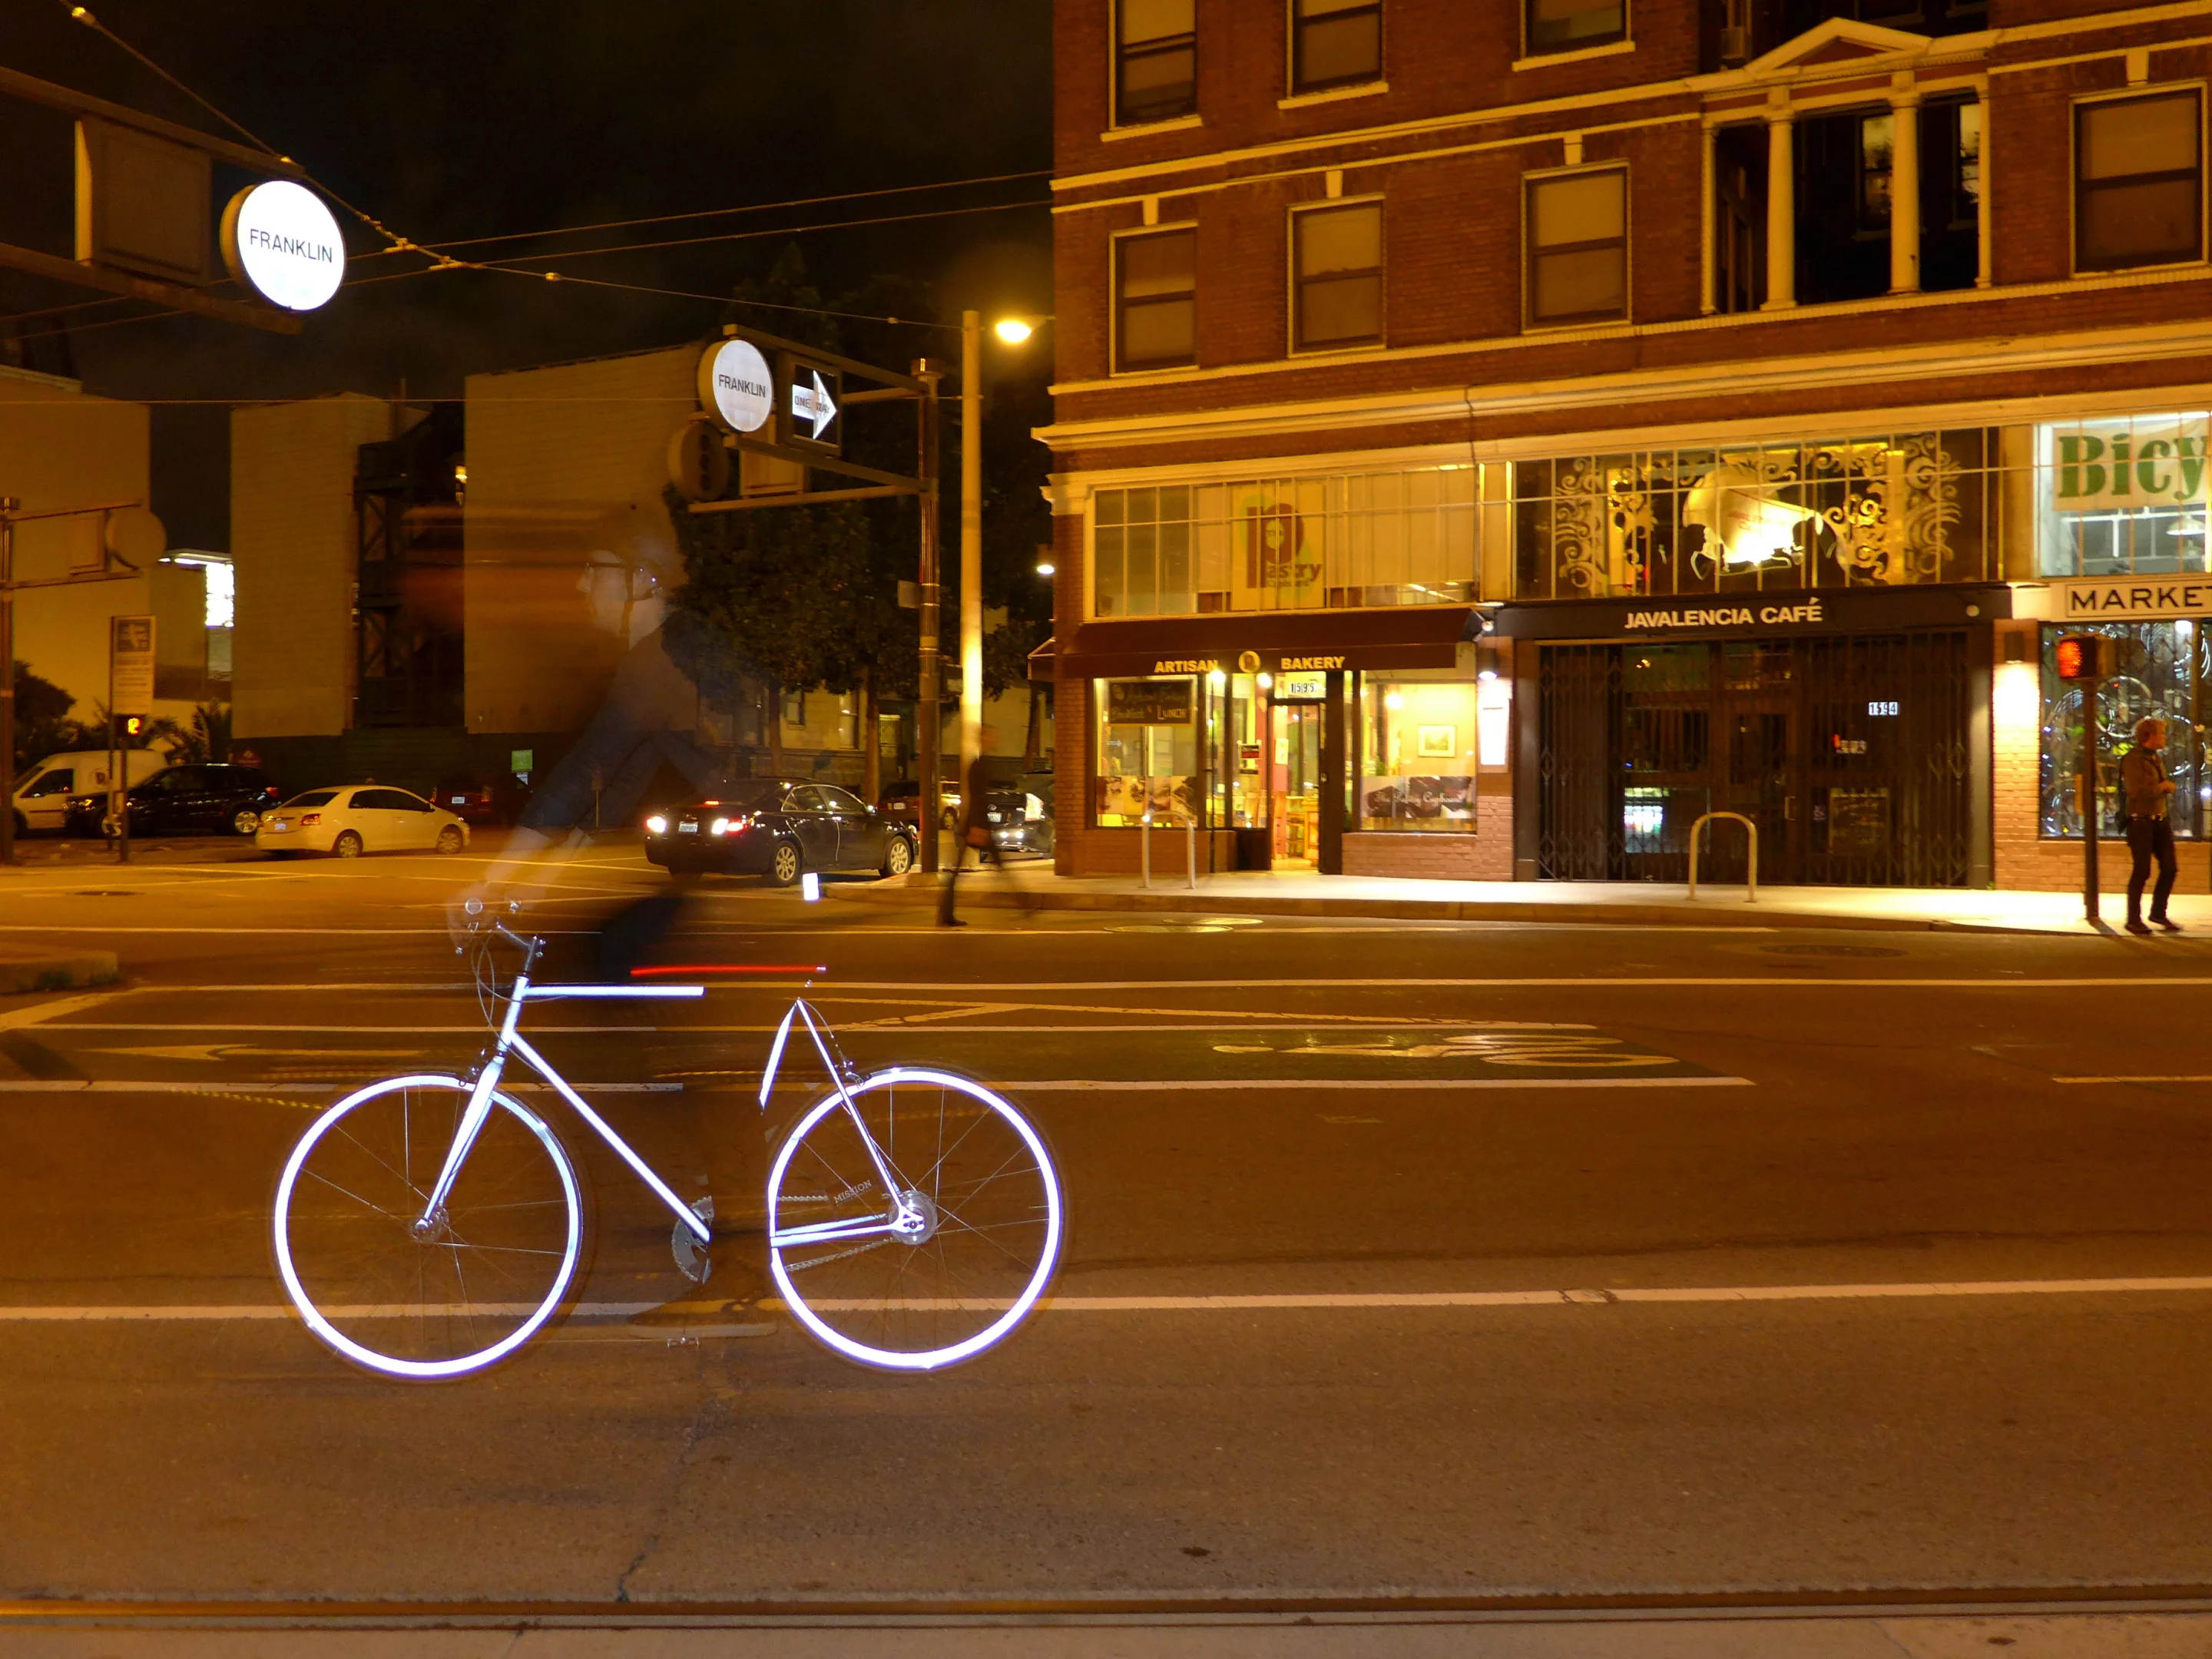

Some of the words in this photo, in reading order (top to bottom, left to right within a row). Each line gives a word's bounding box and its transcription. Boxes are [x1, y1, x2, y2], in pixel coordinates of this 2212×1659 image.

[250, 229, 333, 263] FRANKLIN
[719, 375, 766, 398] FRANKLIN
[795, 396, 811, 409] ONE
[2058, 433, 2209, 500] Bicy
[2071, 586, 2212, 611] MARKE
[1624, 608, 1754, 628] JAVALENCIA
[1760, 597, 1823, 624] CAFÉ
[1154, 660, 1219, 673] ARTISAN
[1281, 657, 1345, 670] BAKERY
[833, 1180, 872, 1204] MISSION
